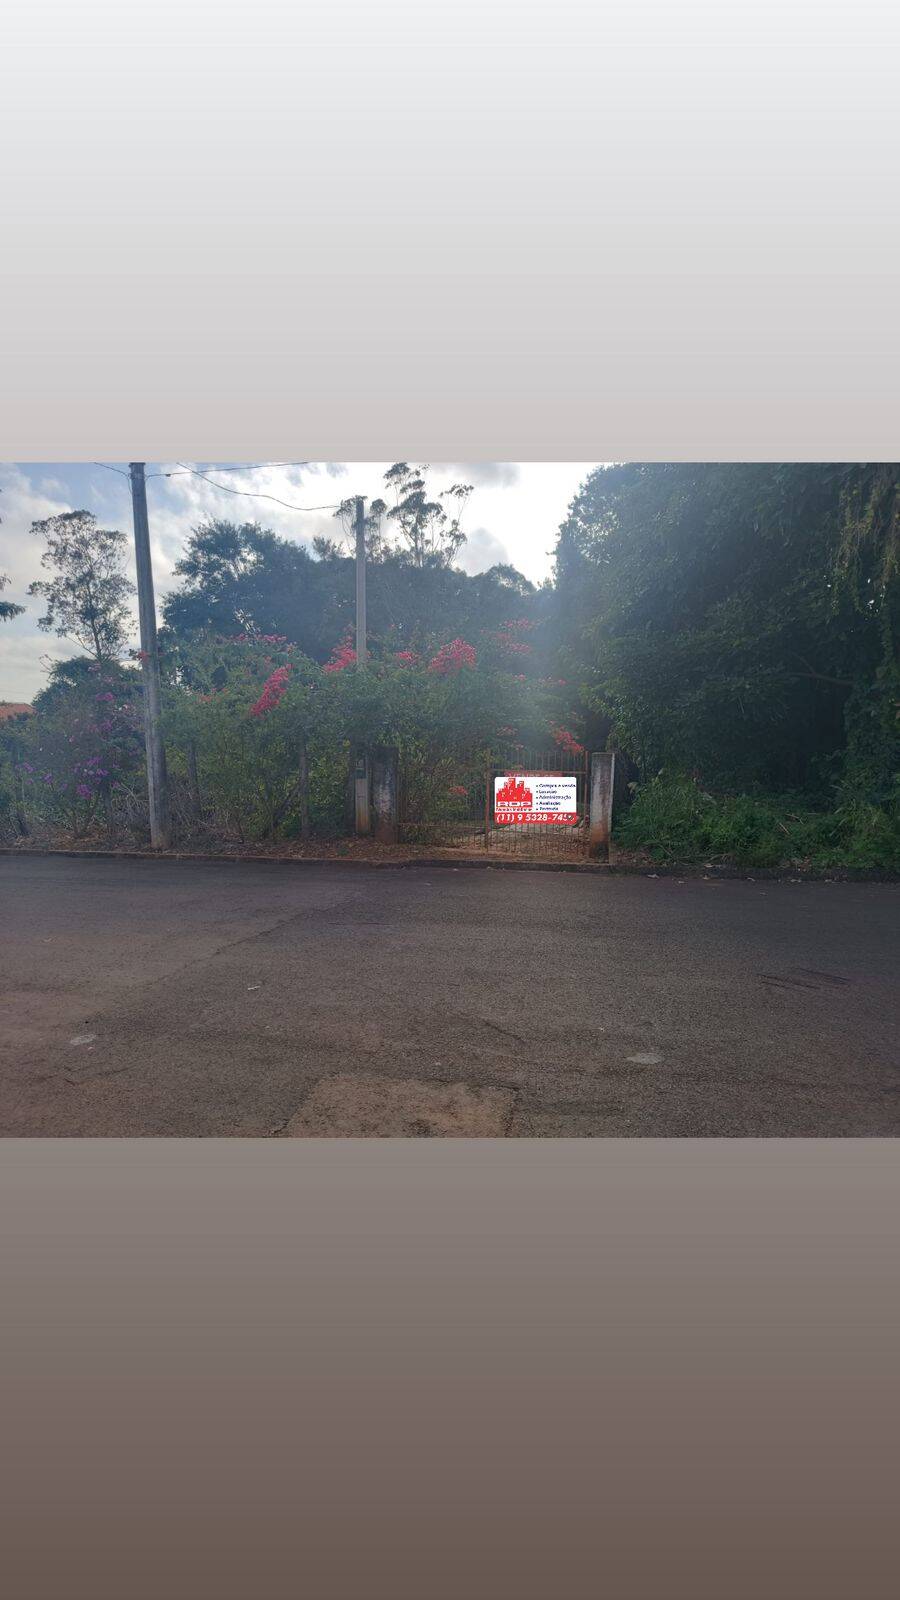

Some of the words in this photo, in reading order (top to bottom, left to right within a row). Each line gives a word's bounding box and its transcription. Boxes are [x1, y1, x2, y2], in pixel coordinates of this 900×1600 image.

[496, 813, 514, 823] (11)
[517, 813, 523, 821] 9
[525, 813, 575, 821] 5328-745
